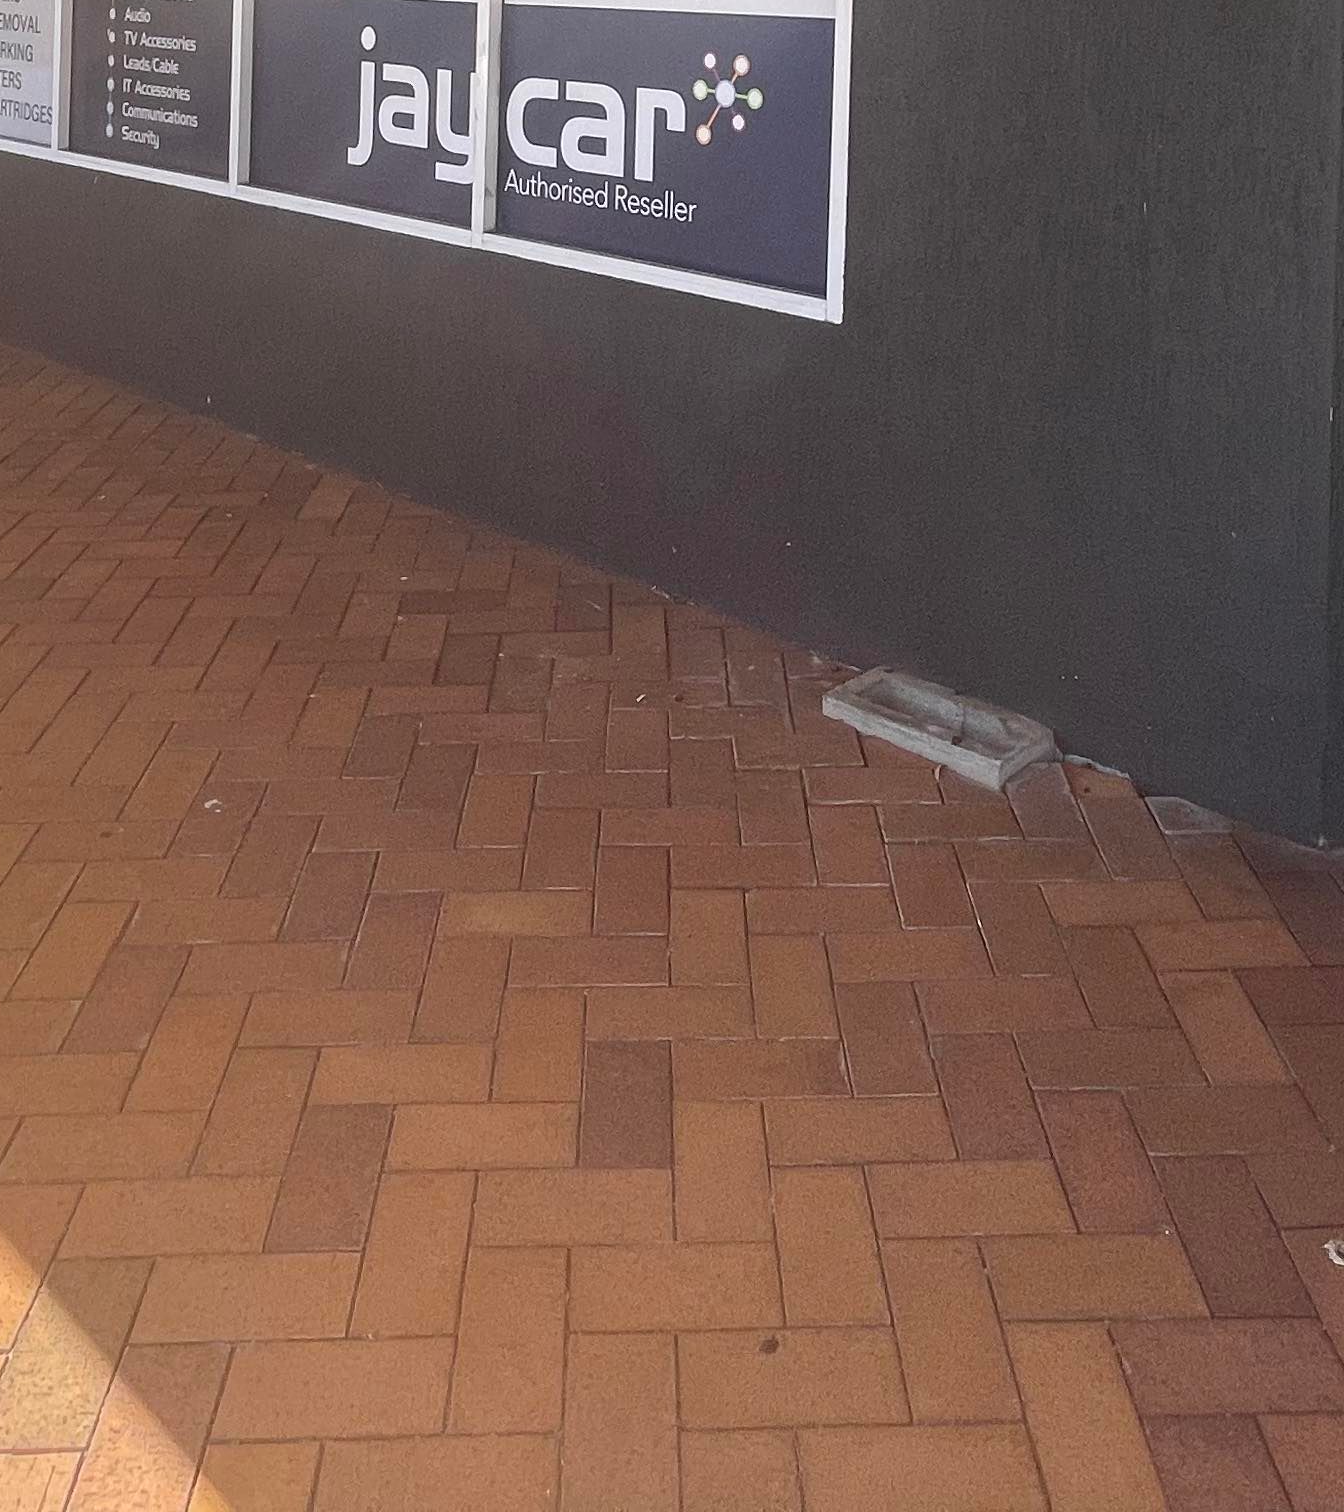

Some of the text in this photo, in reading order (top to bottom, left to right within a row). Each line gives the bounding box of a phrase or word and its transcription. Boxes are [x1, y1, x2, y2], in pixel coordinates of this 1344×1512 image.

[124, 6, 151, 23] Audio
[123, 30, 197, 52] TV Accessories
[122, 78, 191, 101] IT Accessories
[122, 102, 198, 128] Communications
[347, 25, 686, 183] jaycar
[121, 125, 161, 149] Security
[504, 168, 698, 222] Authorised Reseller
